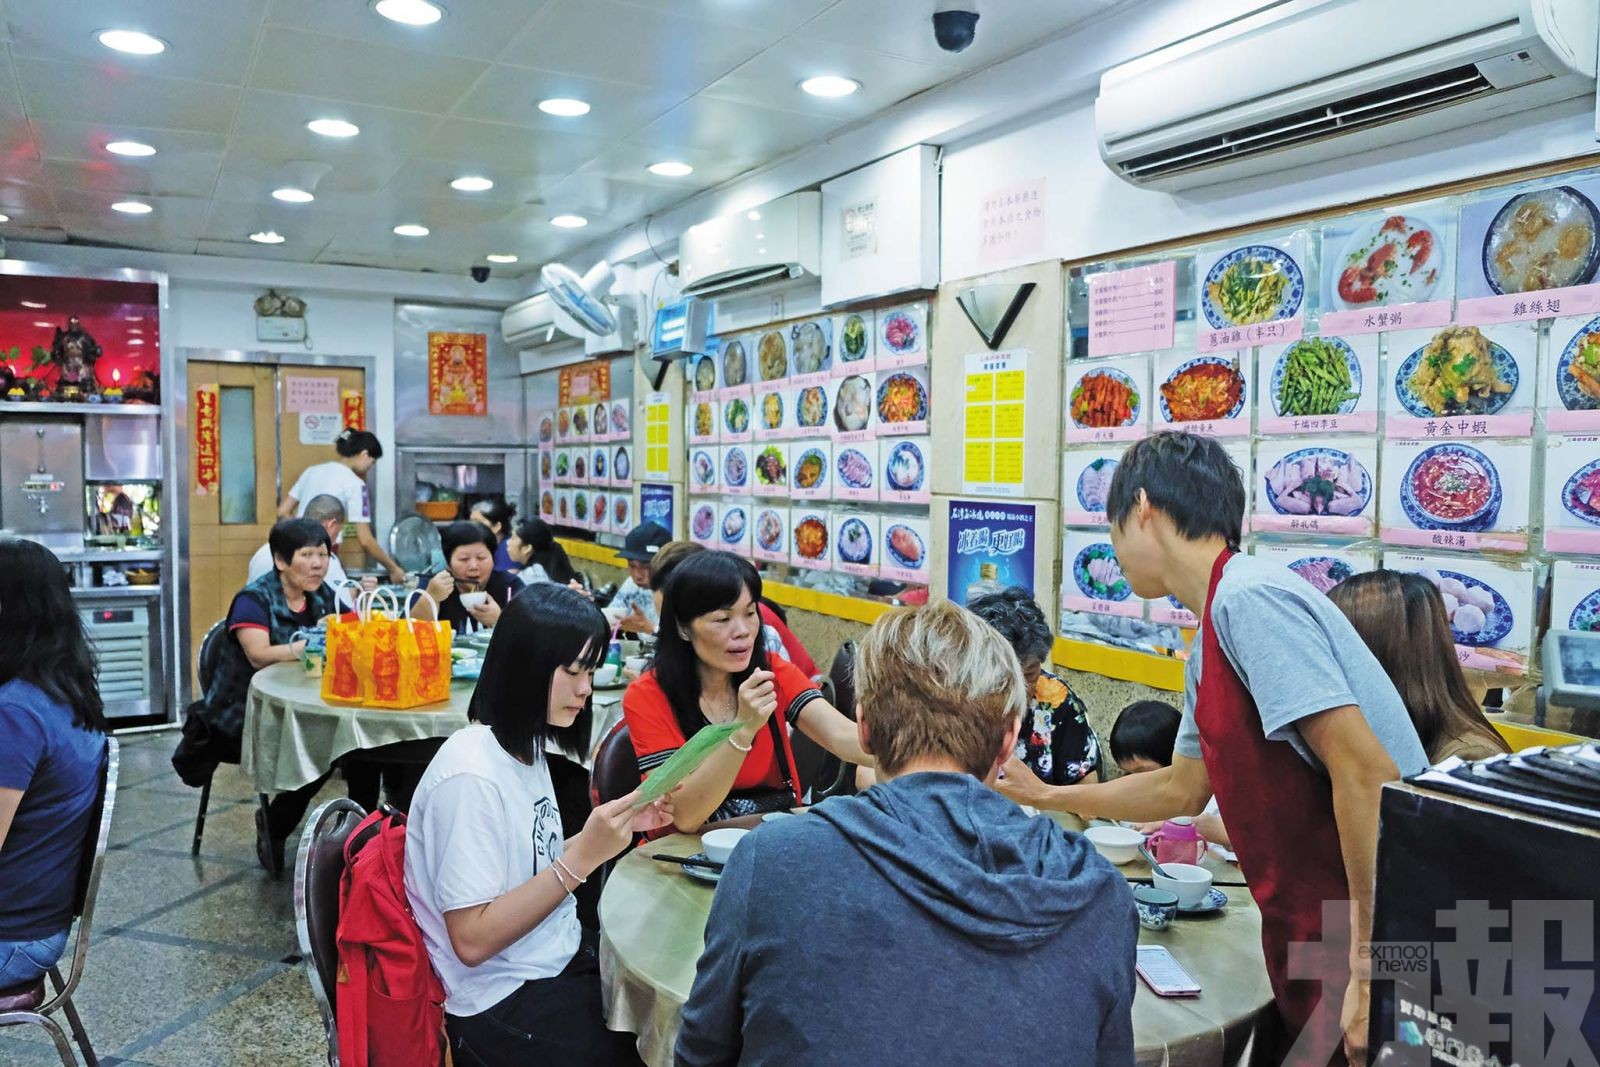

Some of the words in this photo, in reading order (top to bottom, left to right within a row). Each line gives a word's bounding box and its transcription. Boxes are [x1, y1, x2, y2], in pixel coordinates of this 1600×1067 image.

[1512, 299, 1561, 317] 雞絲翅
[1363, 311, 1402, 328] 水蟹粥
[1424, 420, 1488, 437] 黃金中蝦
[1432, 534, 1467, 547] 酸辣湯
